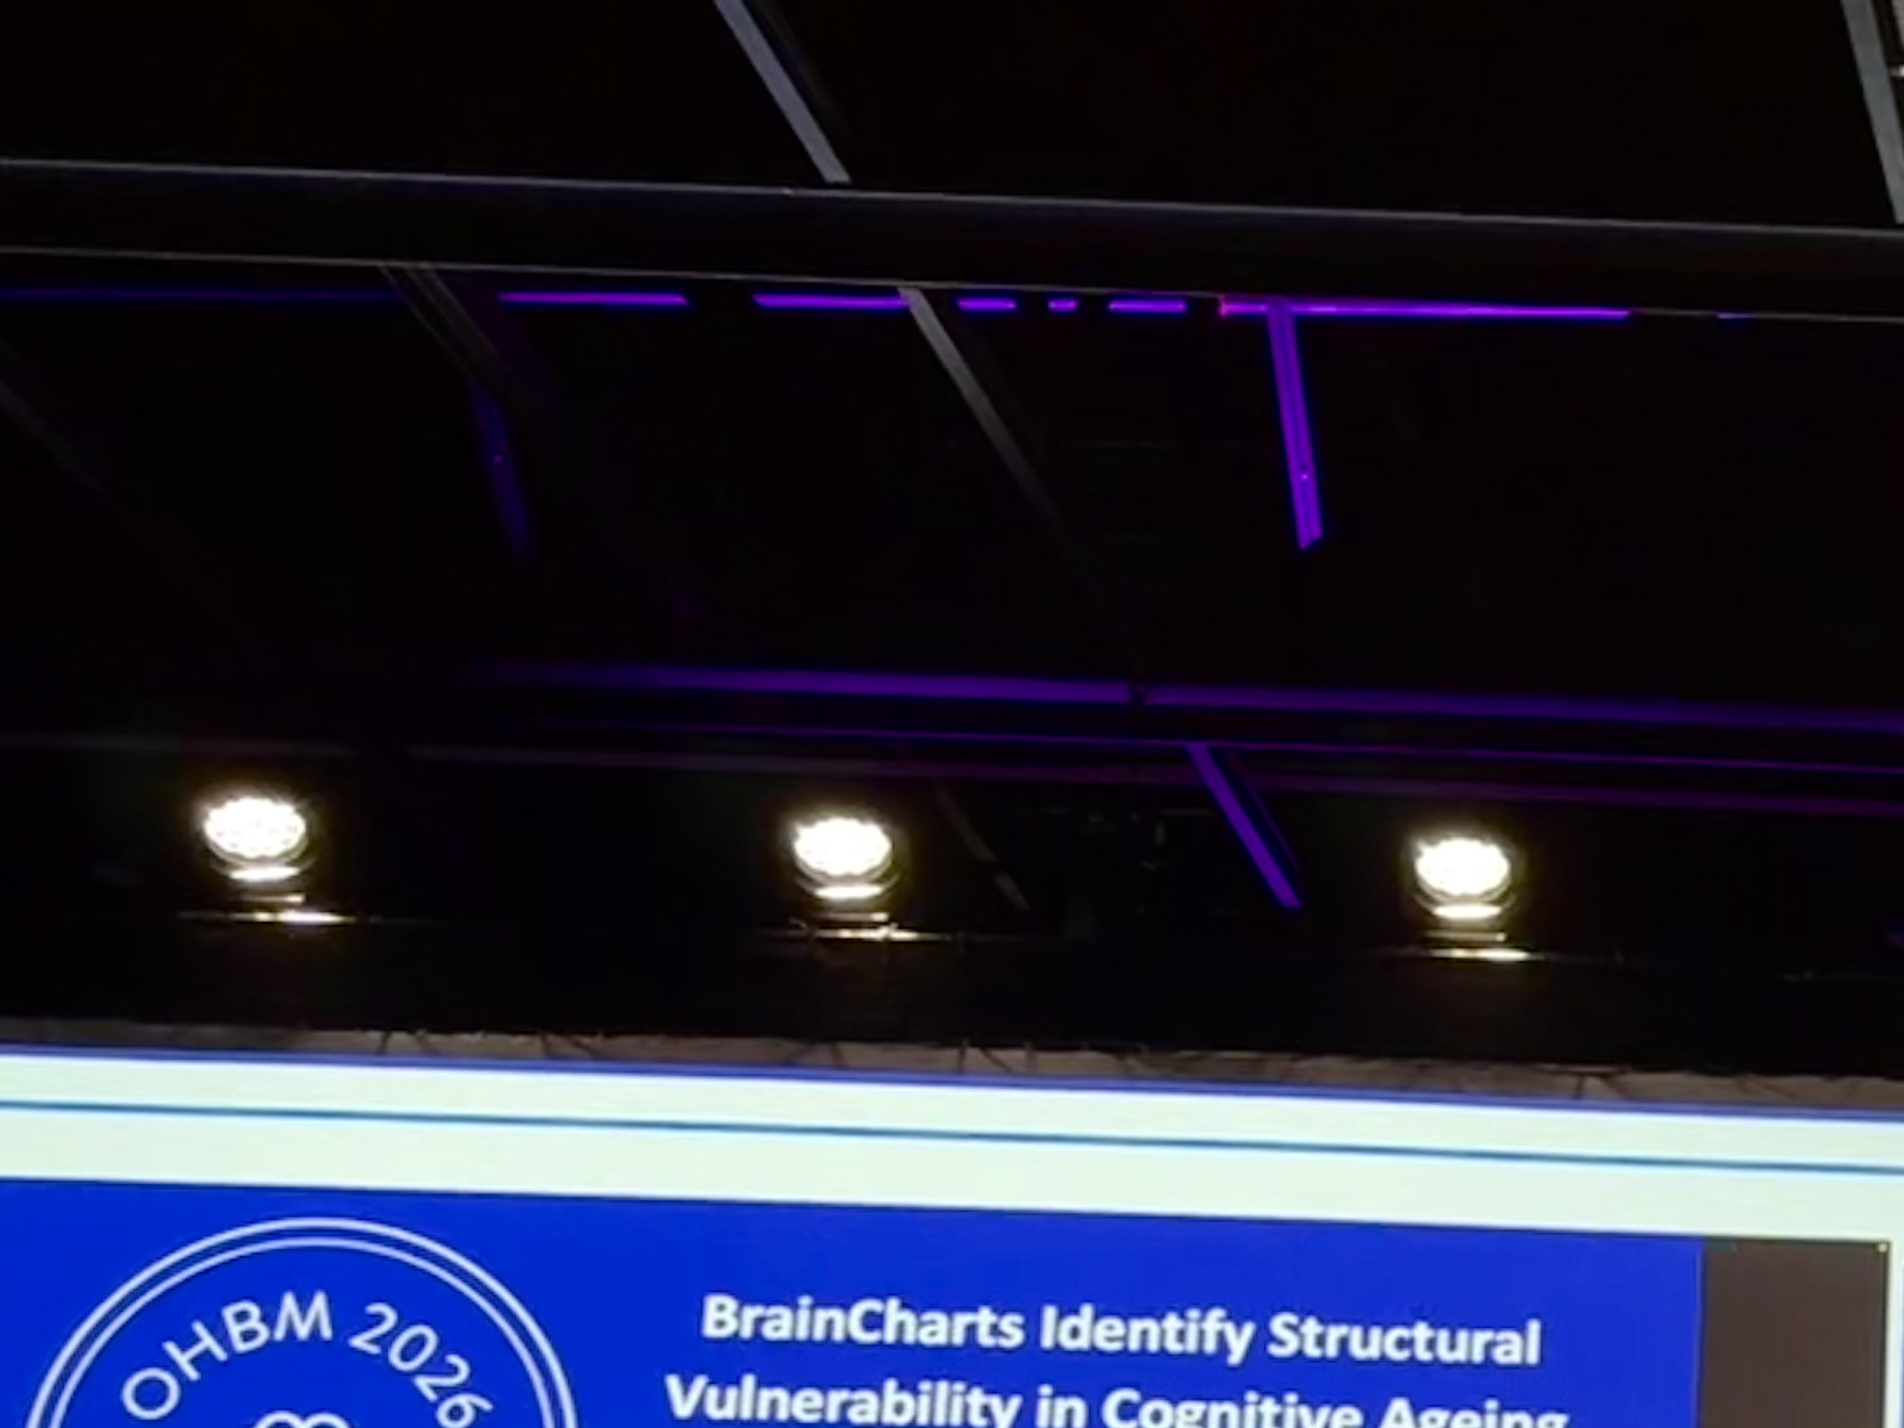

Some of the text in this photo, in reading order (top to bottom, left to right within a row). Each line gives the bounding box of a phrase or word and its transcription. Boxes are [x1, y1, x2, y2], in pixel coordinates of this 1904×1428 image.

[123, 1292, 332, 1419] OHBM
[702, 1294, 1541, 1365] BrainCharts Identify Structural
